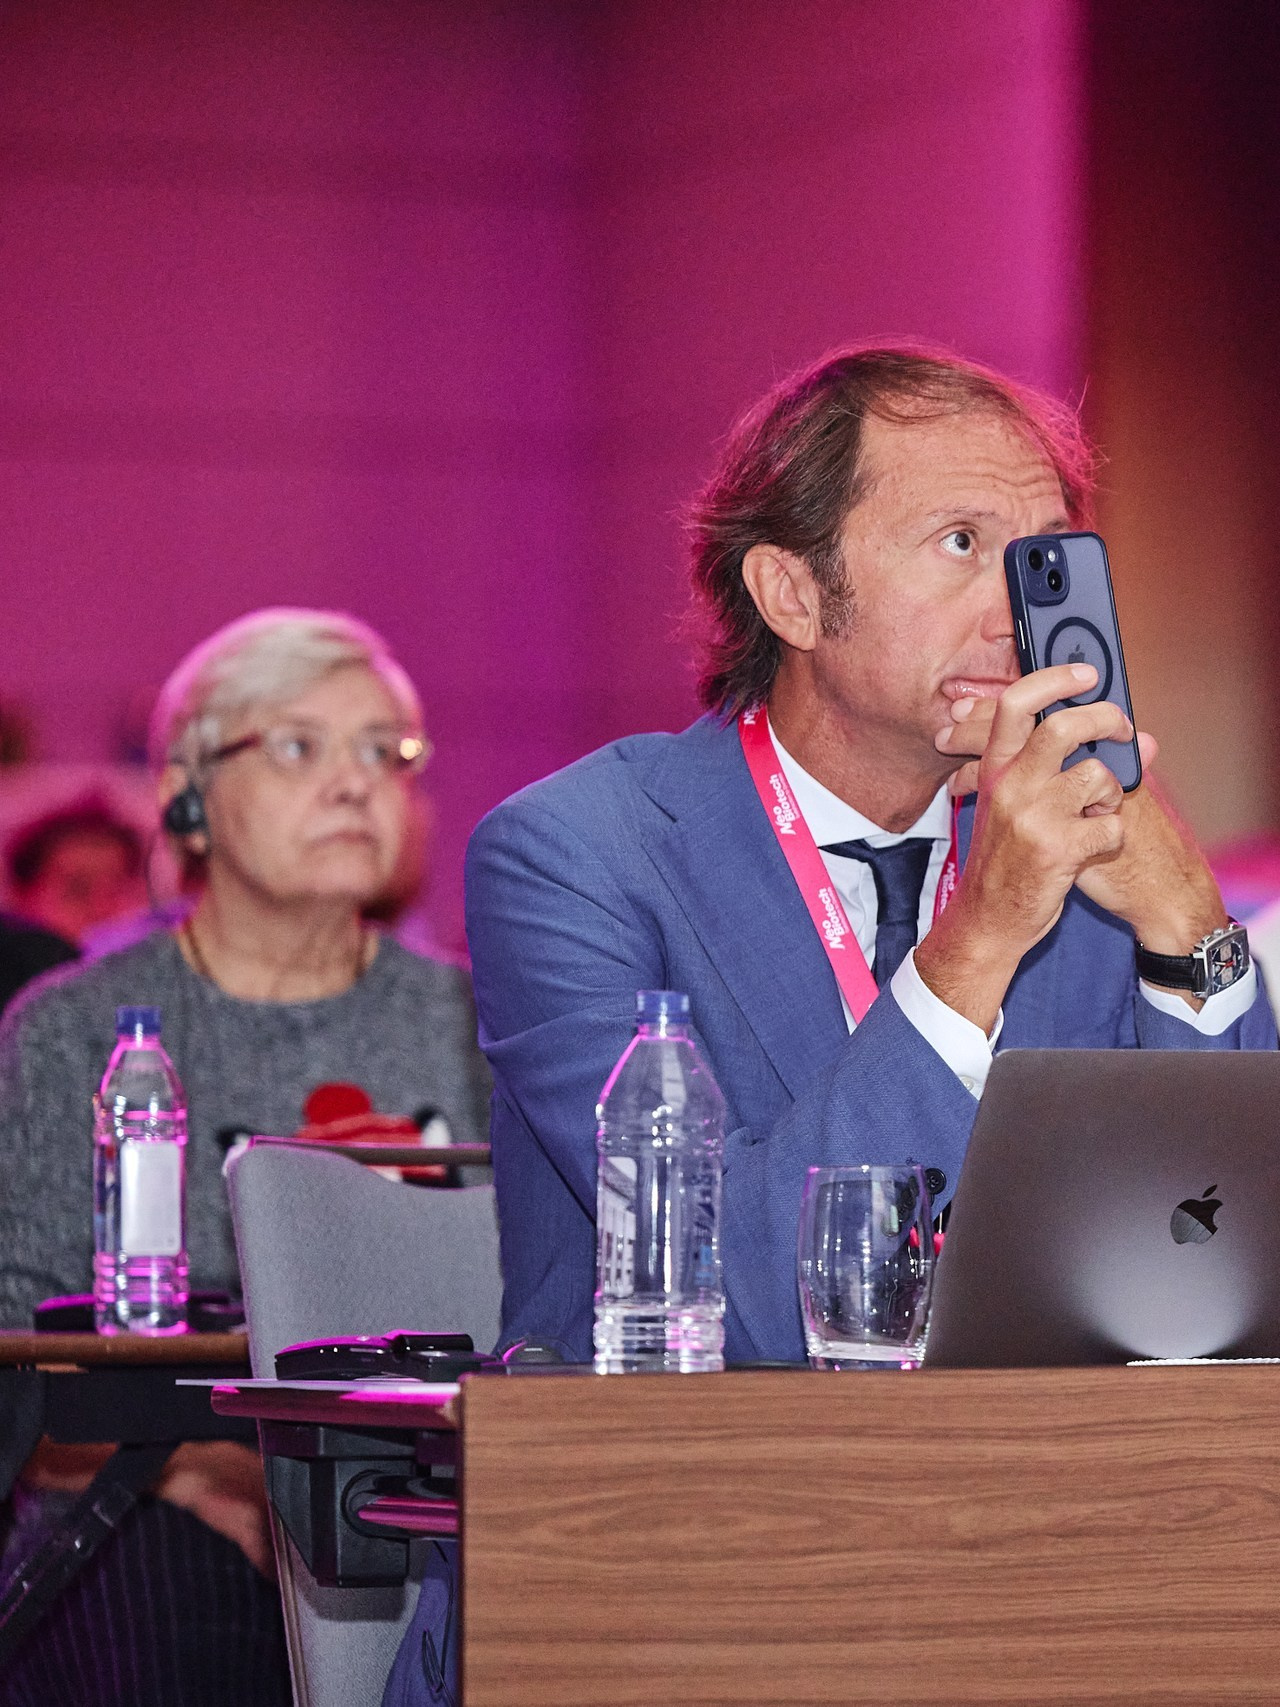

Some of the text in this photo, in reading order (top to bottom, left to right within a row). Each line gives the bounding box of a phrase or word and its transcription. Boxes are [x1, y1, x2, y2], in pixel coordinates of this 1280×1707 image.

[769, 773, 796, 822] Biotech
[773, 805, 796, 835] Neo
[818, 888, 845, 936] Biotech
[822, 919, 846, 950] Neo
